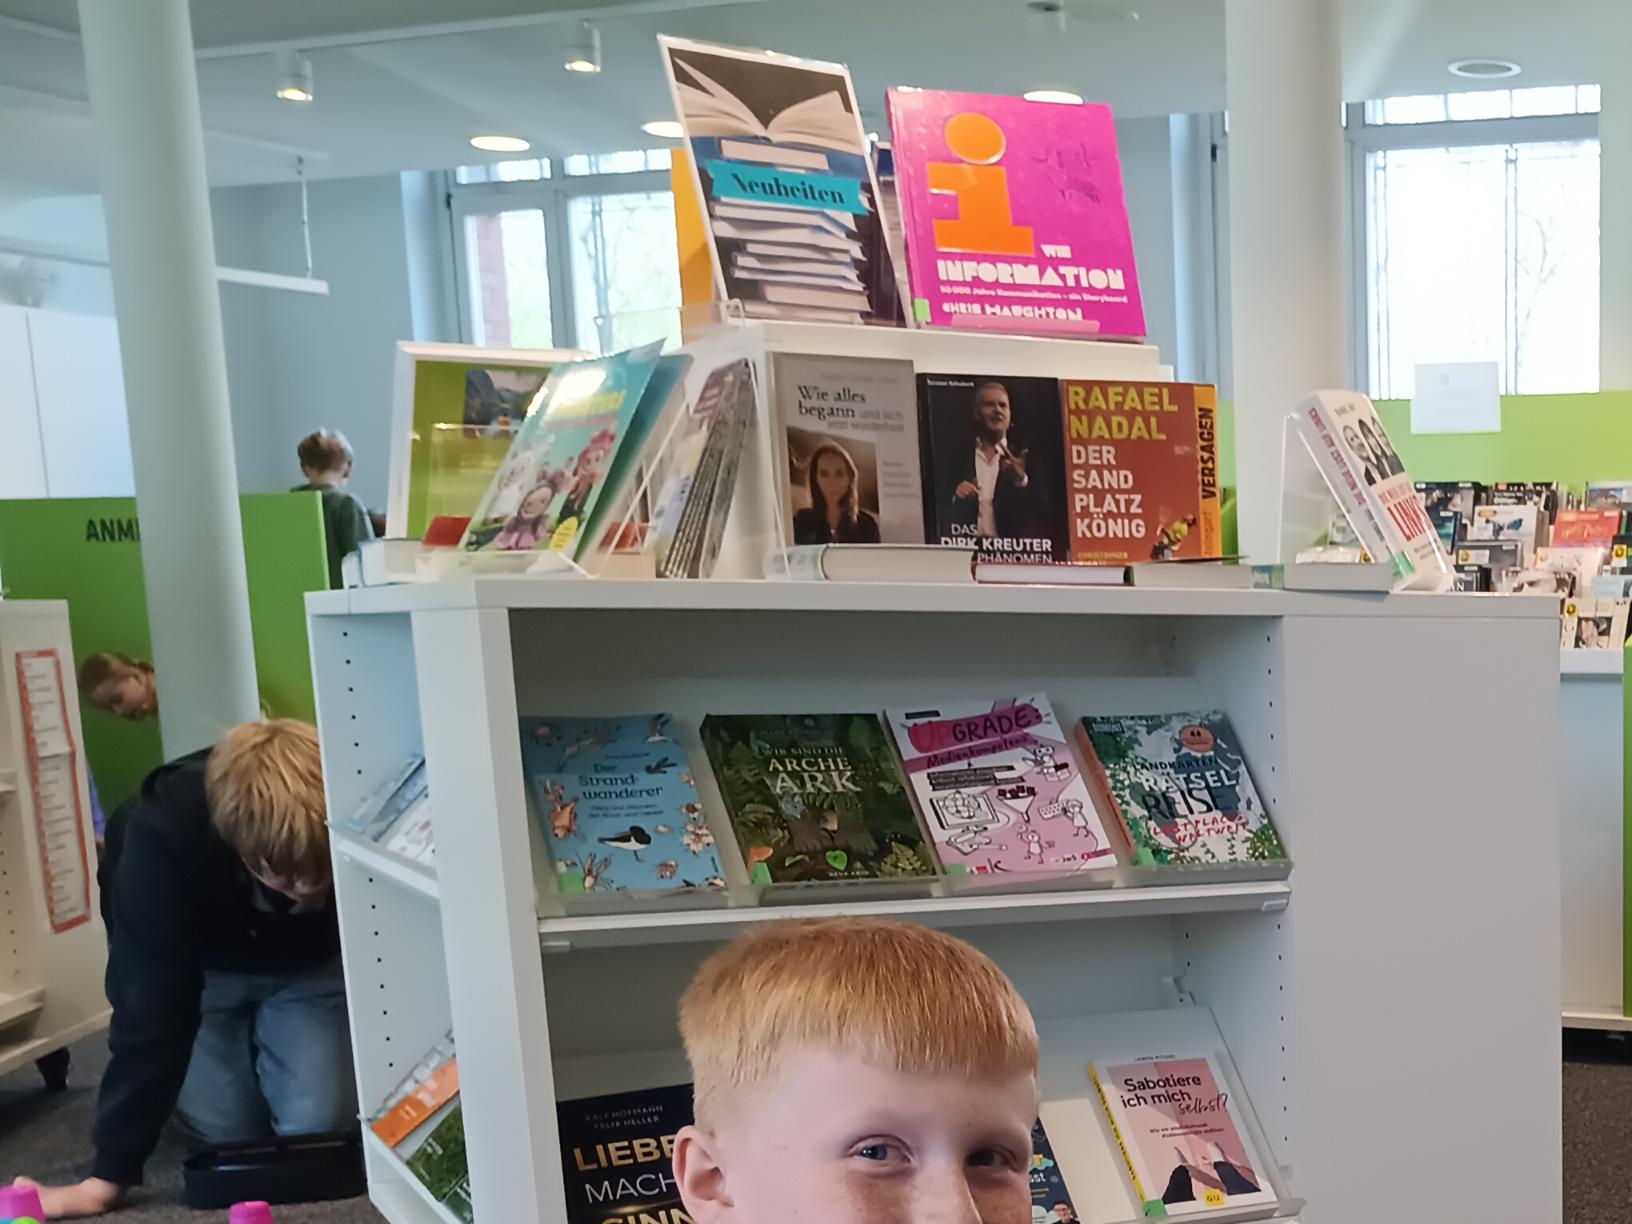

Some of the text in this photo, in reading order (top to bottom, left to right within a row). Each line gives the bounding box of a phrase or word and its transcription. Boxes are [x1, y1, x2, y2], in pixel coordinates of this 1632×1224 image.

[731, 172, 846, 205] Neuheiten
[936, 259, 1125, 290] INFORMATION
[942, 302, 1083, 321] CHRIS HAUGHTON
[797, 385, 866, 403] Wie alles
[1067, 385, 1179, 412] RAFAEL
[798, 400, 856, 421] begann
[1070, 414, 1167, 441] NADAL
[1071, 444, 1117, 466] DER
[1198, 406, 1217, 500] VERSAGEN
[1072, 469, 1134, 490] SAND
[1074, 493, 1144, 514] PLATZ
[951, 523, 978, 536] DAS
[1076, 513, 1146, 539] KÖNIG
[941, 536, 1052, 552] DIRK KREUTER
[593, 763, 619, 773] Der
[768, 757, 852, 773] ARCHE
[578, 774, 640, 787] Strand-
[775, 771, 864, 794] ARK
[1141, 768, 1238, 793] RÄTSEL
[582, 786, 664, 800] wanderer
[1123, 1073, 1202, 1093] Sabotiere
[1119, 1089, 1192, 1109] ich mich
[585, 1172, 677, 1204] MACH
